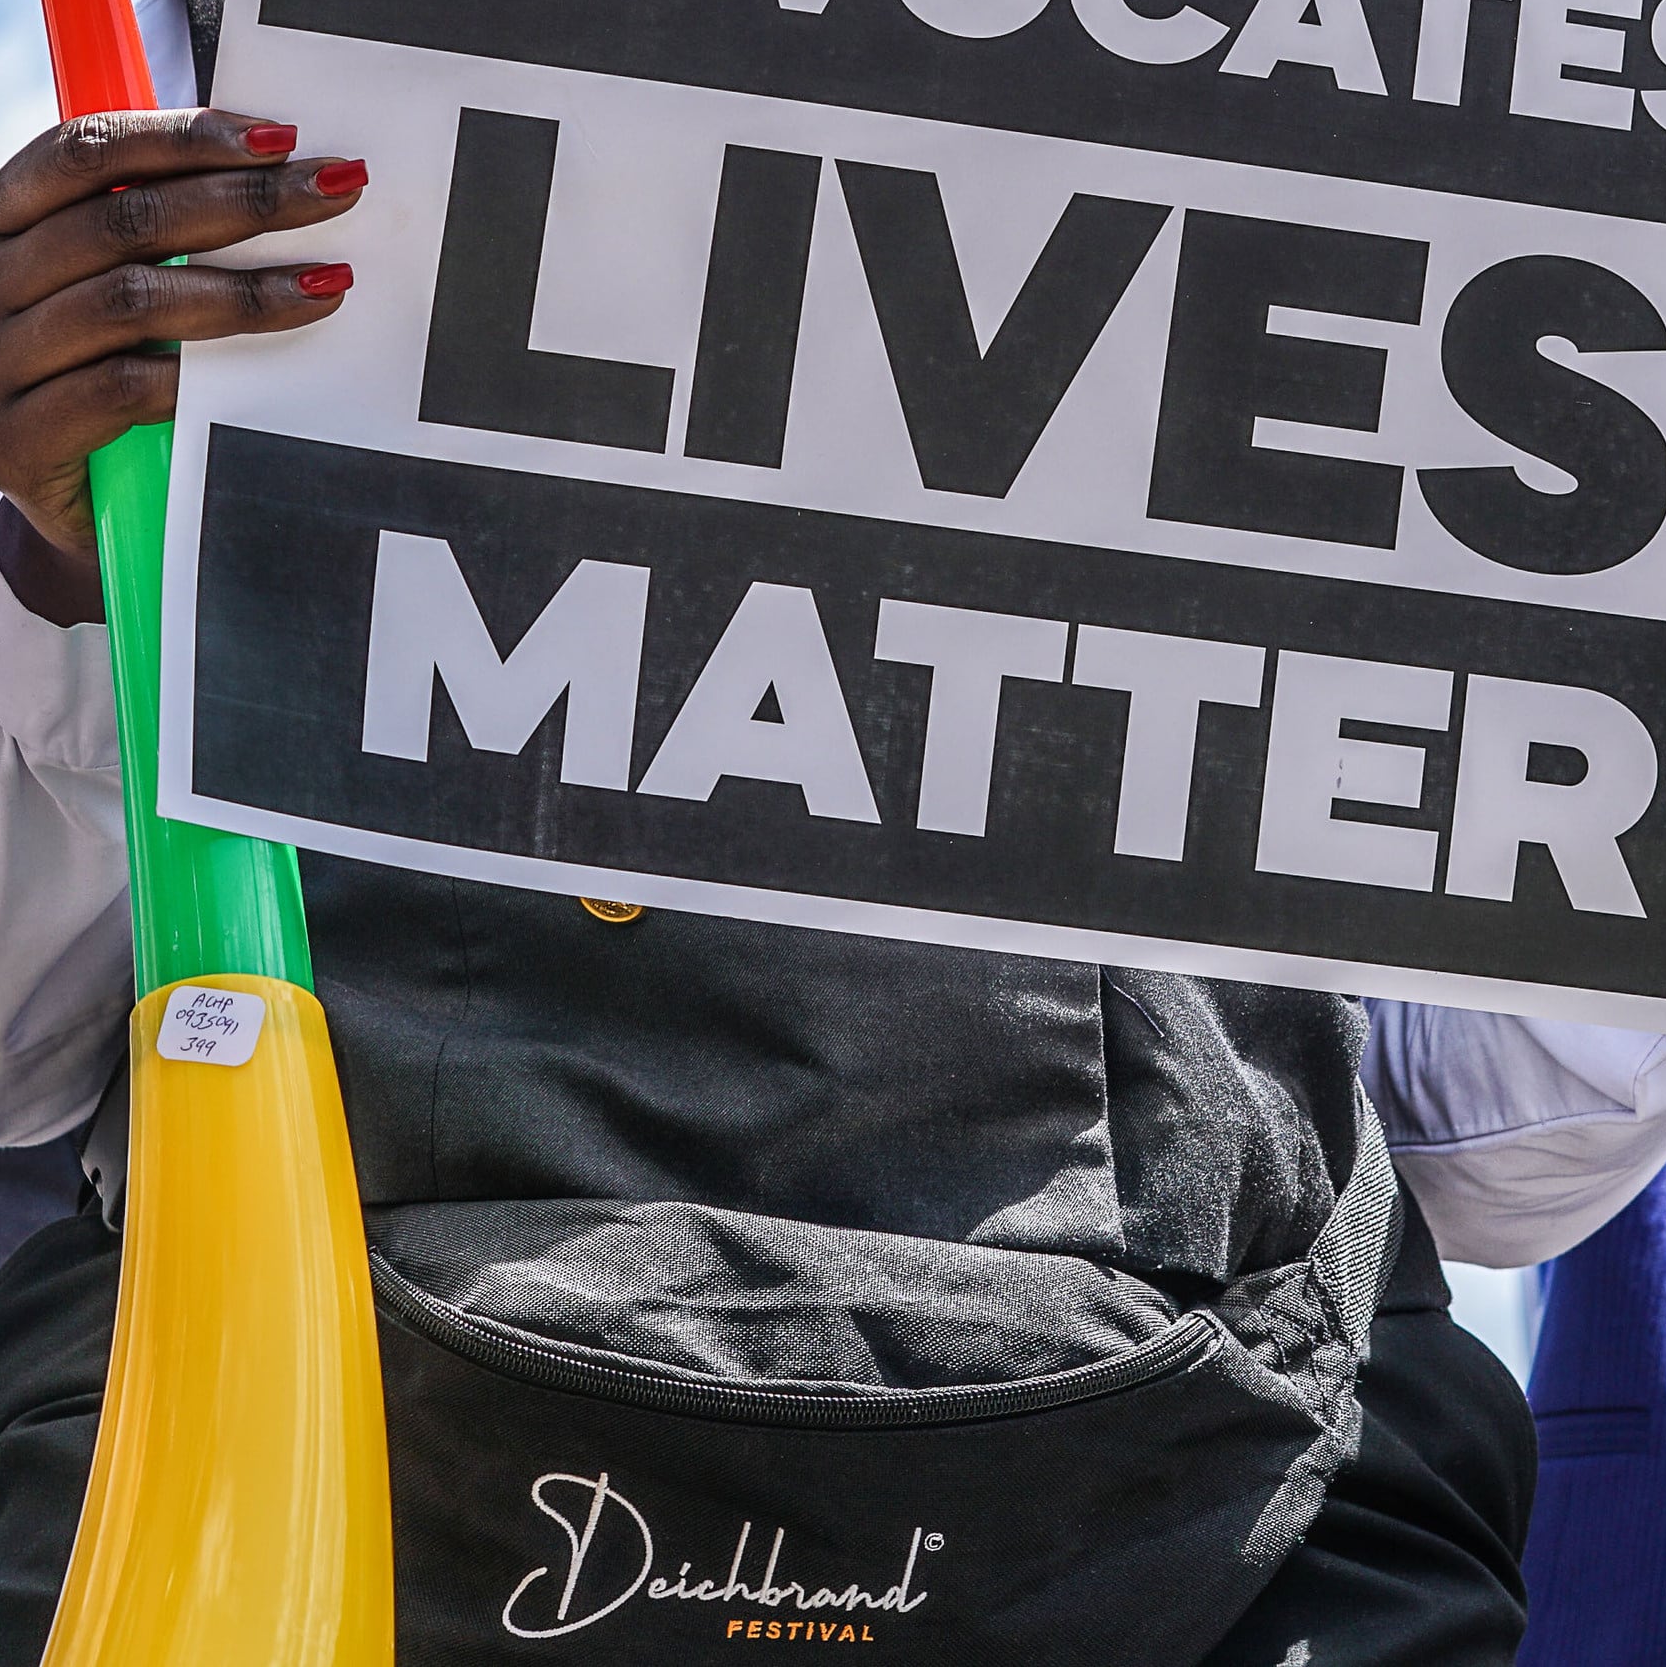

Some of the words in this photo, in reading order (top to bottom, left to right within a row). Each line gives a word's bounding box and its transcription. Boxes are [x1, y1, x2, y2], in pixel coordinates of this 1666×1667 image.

[362, 530, 1659, 919] MATTER
[180, 1036, 216, 1057] 399
[727, 1620, 875, 1642] FESTIVAL
